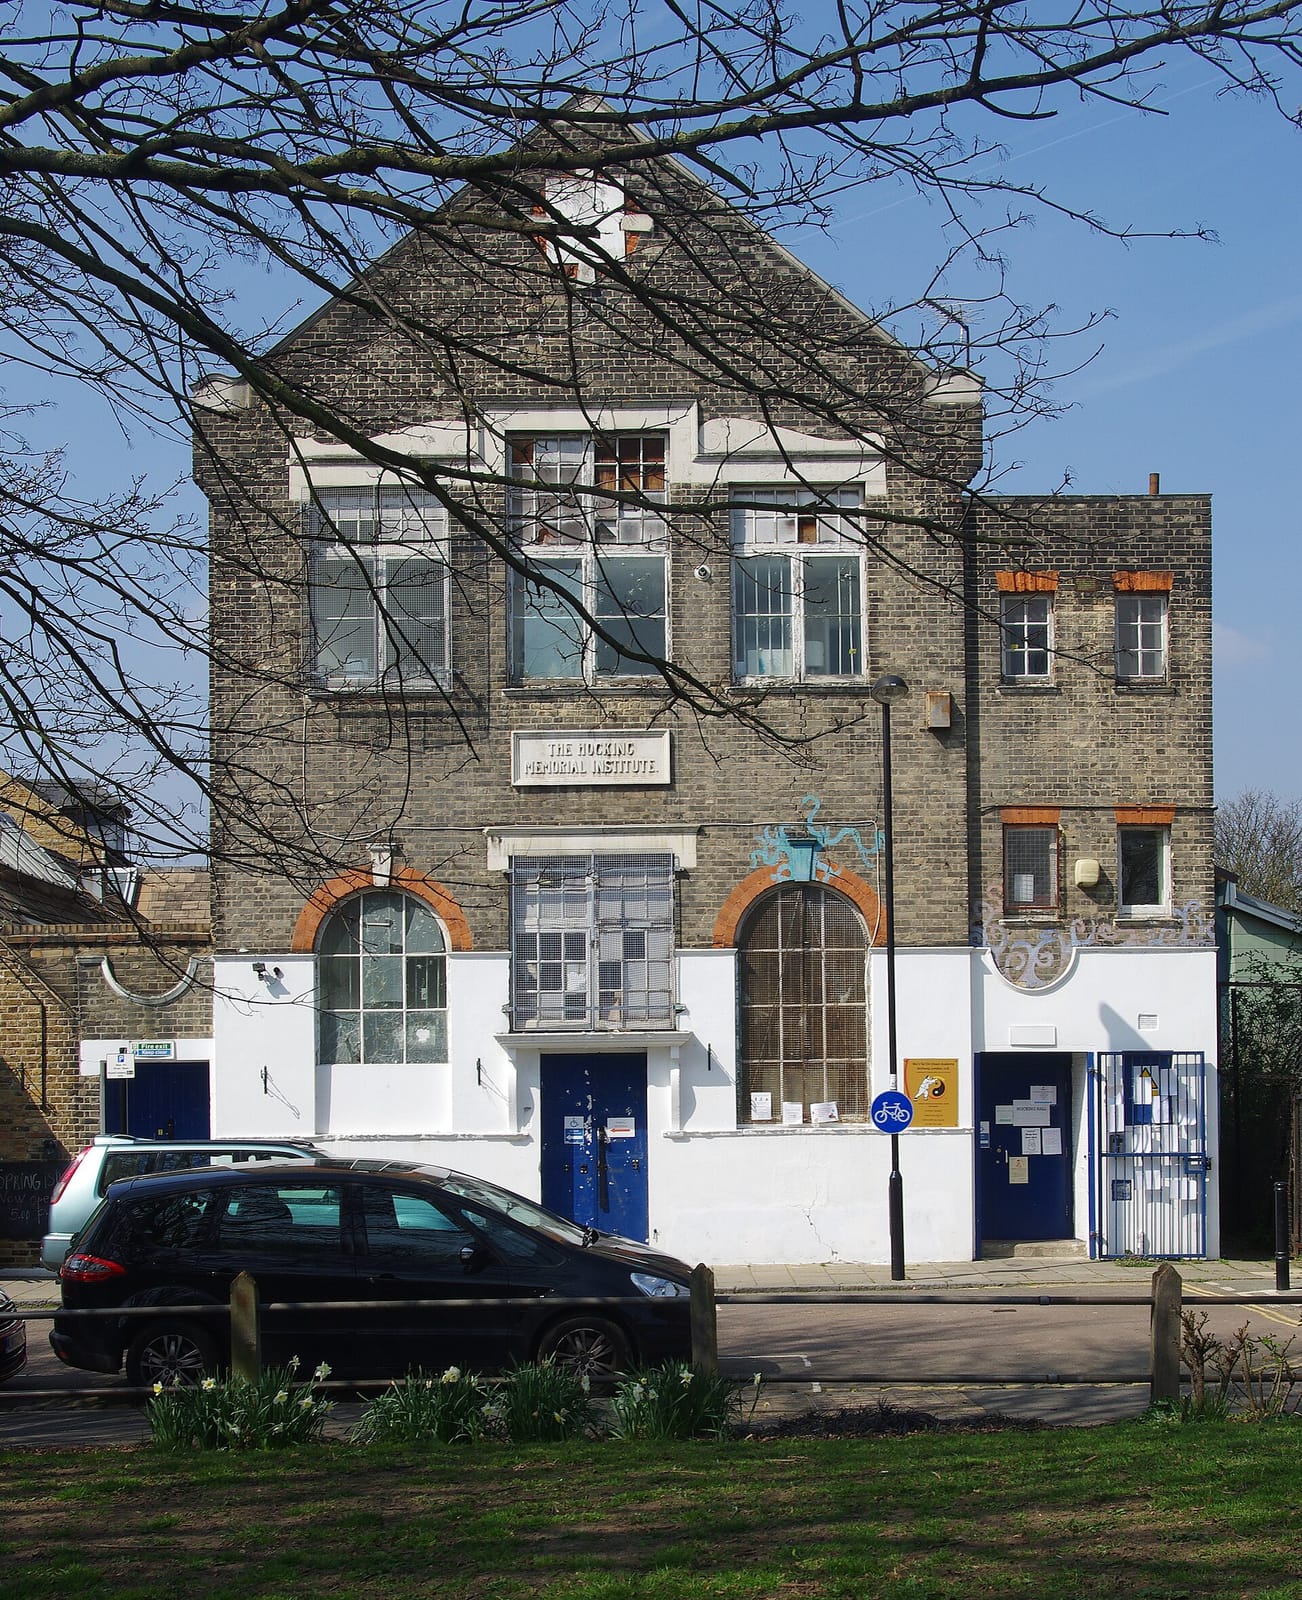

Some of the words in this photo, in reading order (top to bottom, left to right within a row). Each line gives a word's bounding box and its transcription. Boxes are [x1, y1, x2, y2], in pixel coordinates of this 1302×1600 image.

[548, 743, 573, 757] THE
[577, 743, 636, 758] HOCKING
[525, 761, 587, 775] MEMORIAL
